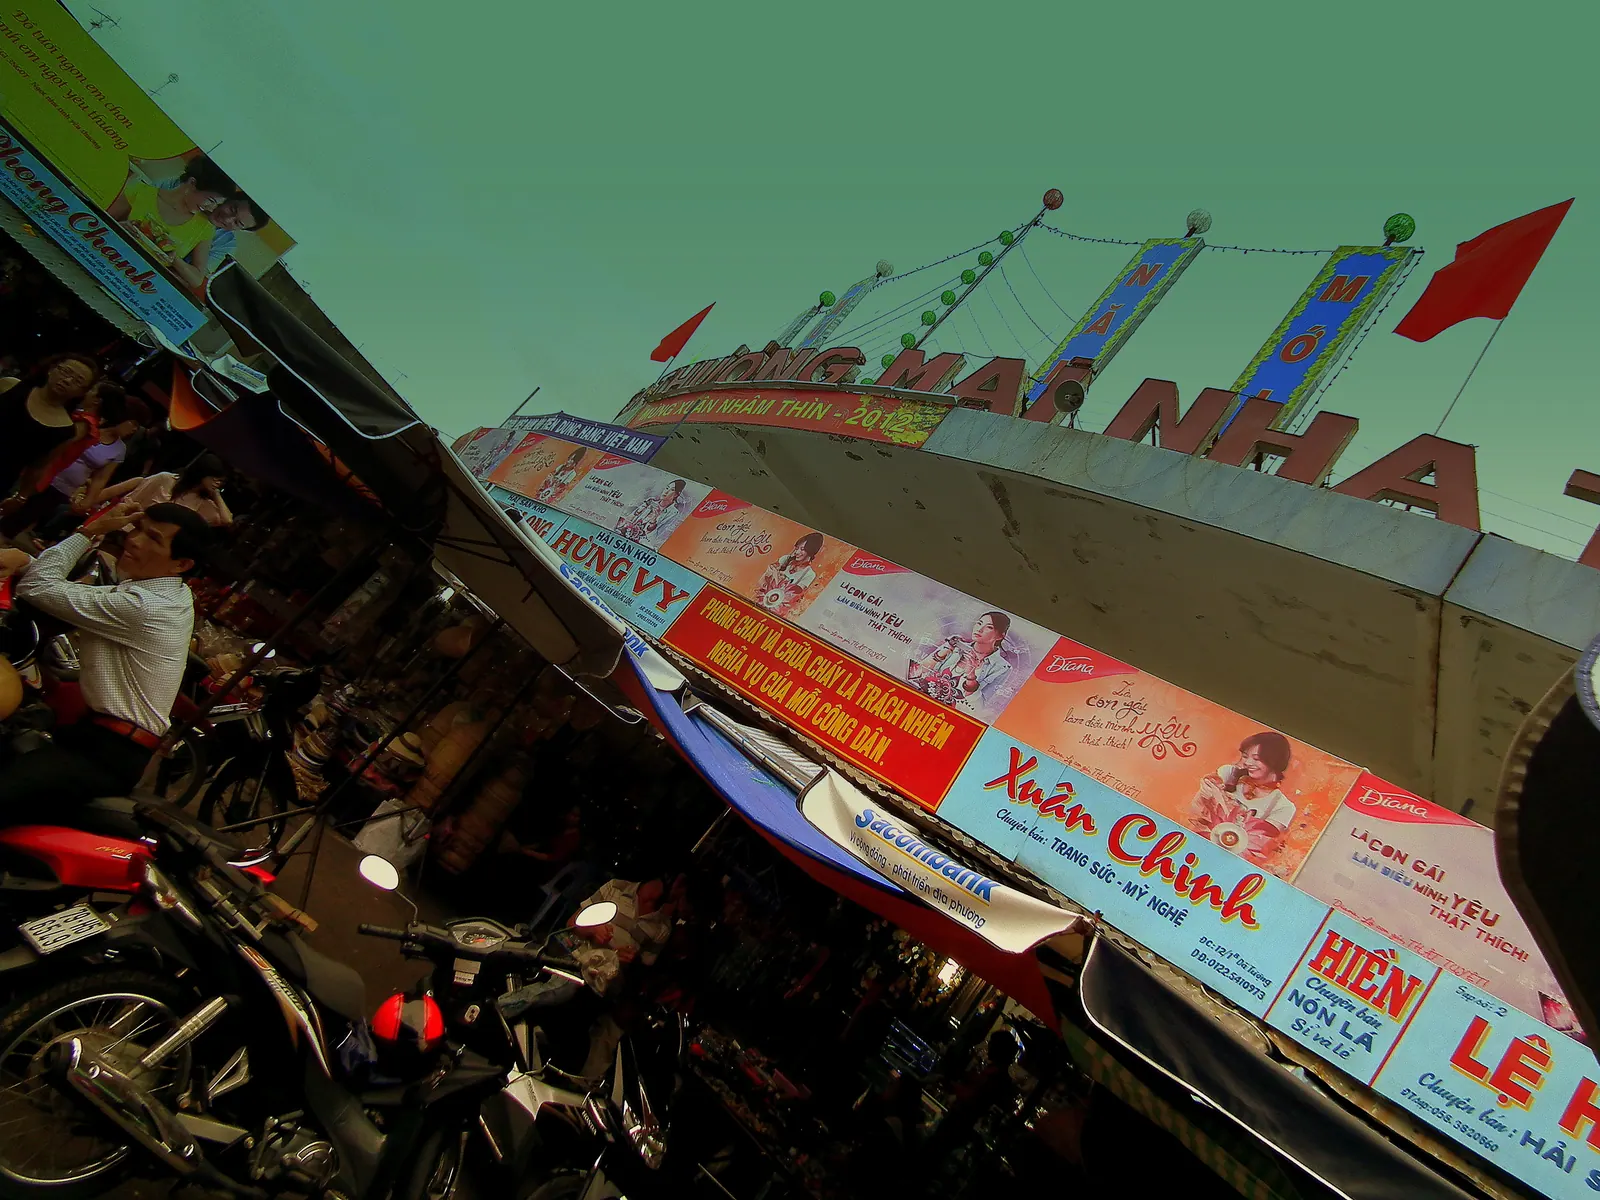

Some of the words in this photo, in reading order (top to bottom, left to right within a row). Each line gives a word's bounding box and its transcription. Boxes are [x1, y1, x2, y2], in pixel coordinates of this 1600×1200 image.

[19, 44, 40, 62] em
[56, 50, 87, 83] ngon
[86, 83, 106, 101] em
[69, 212, 158, 294] Chanh
[716, 395, 776, 416] NHÂM
[776, 397, 832, 421] THÌN
[845, 407, 914, 434] 2012
[625, 438, 654, 456] NAM
[1103, 378, 1481, 533] NHA
[595, 531, 614, 545] HẢI
[613, 537, 632, 555] SẢN
[632, 548, 658, 567] KHÔ
[850, 556, 886, 573] Diana
[632, 566, 690, 613] VY
[848, 586, 867, 600] CON
[866, 594, 884, 607] GÁI
[879, 611, 905, 628] YÊU
[887, 628, 913, 645] THÍCH!
[699, 597, 735, 630] PHÒNG
[732, 614, 769, 645] CHÁY
[760, 627, 785, 657] VÀ
[774, 638, 815, 673] CHỮA
[806, 655, 845, 690] CHÁY
[836, 669, 865, 701] LÀ
[857, 682, 909, 727] TRÁCH
[899, 705, 956, 751] NHIỆM
[1046, 655, 1095, 676] Diana
[706, 639, 751, 676] NGHĨA
[742, 659, 769, 688] VỤ
[761, 671, 794, 706] CỦA
[785, 687, 823, 720] MỖI
[811, 700, 859, 745] CÔNG
[849, 726, 893, 767] DÂN.
[1085, 694, 1118, 711] con
[1115, 697, 1148, 719] gái
[1136, 716, 1197, 761] yêu
[1357, 785, 1428, 819] Diana
[855, 809, 1001, 903] Sacombank
[983, 746, 1098, 836] Xuân
[1106, 813, 1268, 931] Chinh
[1350, 827, 1369, 843] LÀ
[1367, 837, 1409, 865] CON
[1411, 859, 1445, 884] GÁI
[996, 808, 1029, 838] Chuyên
[1027, 825, 1049, 846] bán:
[1050, 837, 1090, 868] TRANG
[1089, 860, 1116, 885] SỨC
[1122, 880, 1151, 903] MỸ
[1149, 894, 1190, 929] NGHỆ
[1352, 850, 1379, 871] LÀM
[1412, 879, 1449, 905] MÌNH
[1450, 892, 1500, 927] YÊU
[892, 862, 913, 884] phát
[911, 872, 931, 894] triển
[932, 887, 948, 904] địa
[948, 899, 987, 929] phương
[1429, 903, 1472, 931] THẬT
[1475, 926, 1530, 963] THÍCH!
[1307, 929, 1426, 1023] HIỀN
[1404, 938, 1445, 962] THẬT
[1444, 958, 1491, 987] TUYỆT!
[1287, 987, 1336, 1029] NÓN
[1338, 1019, 1377, 1054] LÁ
[1305, 977, 1357, 1015] Chuyên
[1355, 1004, 1383, 1031] bán
[1494, 1007, 1509, 1018] 2
[1314, 1032, 1334, 1050] và
[1449, 1014, 1556, 1112] LỆ
[1418, 1072, 1476, 1115] Chuyên
[1520, 1130, 1577, 1174] HẢI
